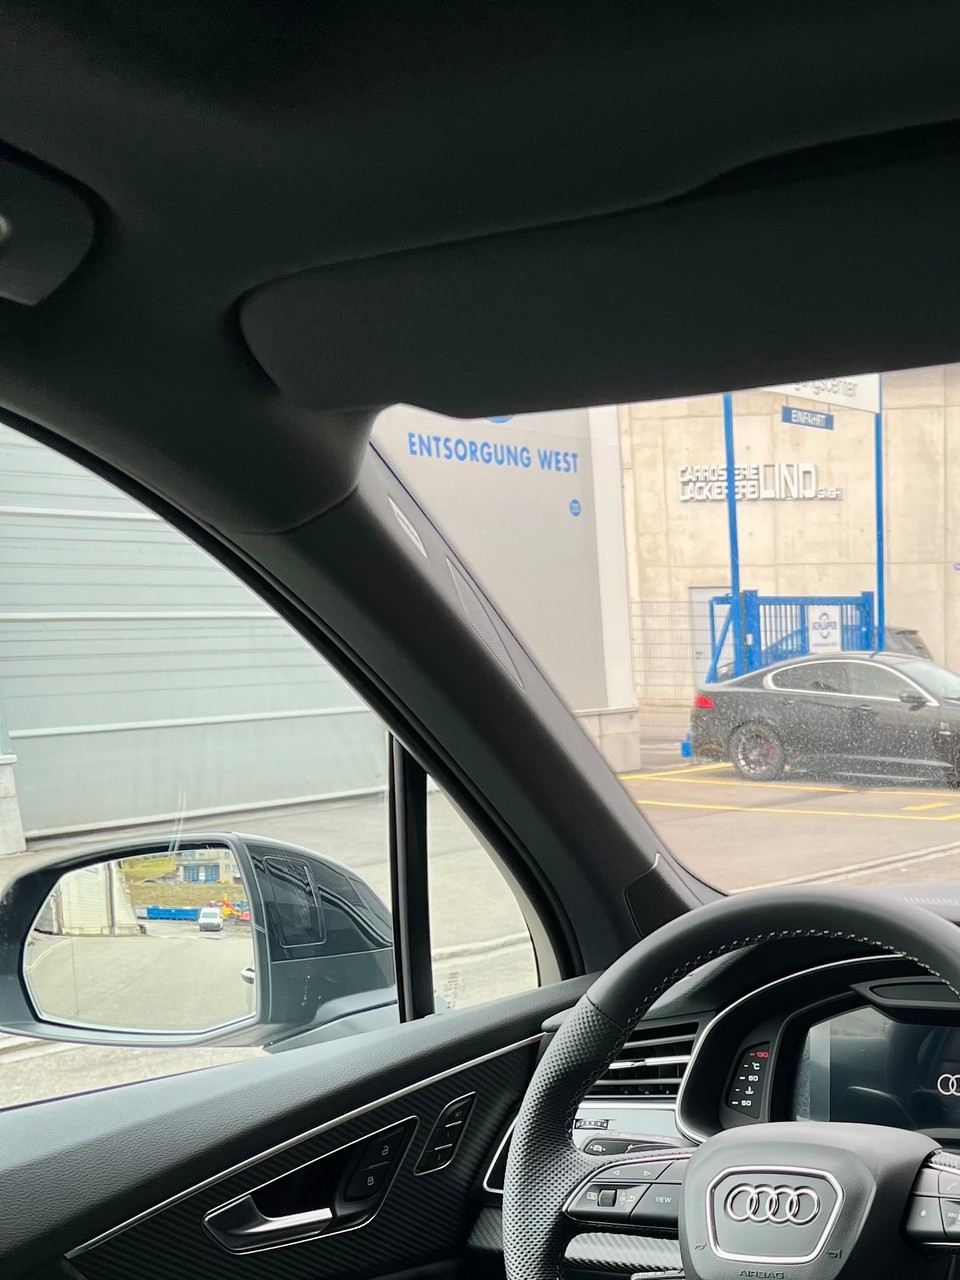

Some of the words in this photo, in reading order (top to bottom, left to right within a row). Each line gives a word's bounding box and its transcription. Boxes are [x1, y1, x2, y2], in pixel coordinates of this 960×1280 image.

[791, 409, 826, 427] EINFAHRT
[408, 432, 532, 468] ENTSORGUNG
[537, 448, 578, 473] WEST
[678, 464, 760, 481] CARROSERIE
[760, 463, 818, 499] LIND
[655, 1196, 672, 1204] VIEW
[739, 1270, 785, 1279] AIRBAG
